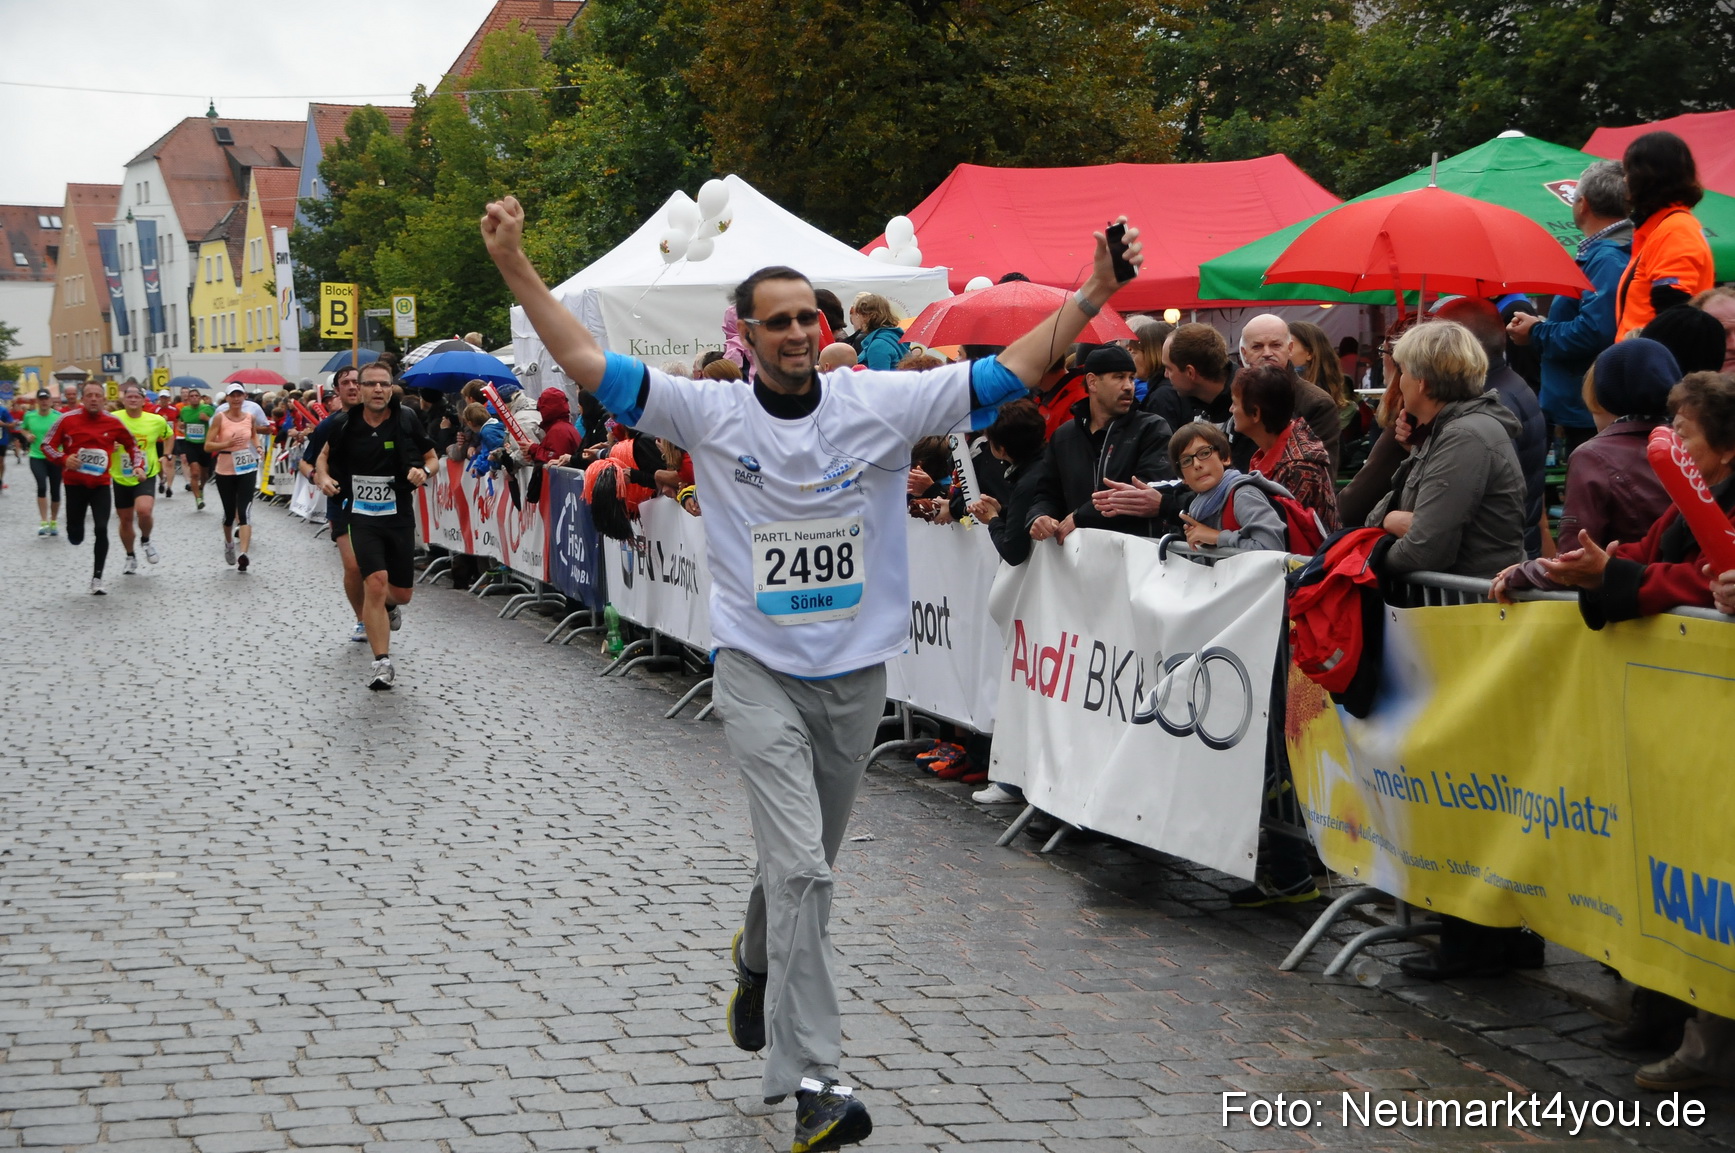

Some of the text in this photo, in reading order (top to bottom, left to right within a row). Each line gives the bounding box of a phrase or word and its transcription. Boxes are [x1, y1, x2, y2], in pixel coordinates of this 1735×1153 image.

[325, 285, 353, 296] Block
[330, 300, 348, 326] B
[628, 338, 690, 356] Kinder
[81, 453, 105, 467] 2202
[735, 469, 764, 485] PARTL
[357, 485, 392, 501] 2232
[754, 528, 846, 543] PARTL Neumarkt
[765, 542, 854, 586] 2498
[790, 593, 833, 611] Sönke
[1011, 619, 1079, 703] Audi
[1446, 858, 1482, 879] Stufen
